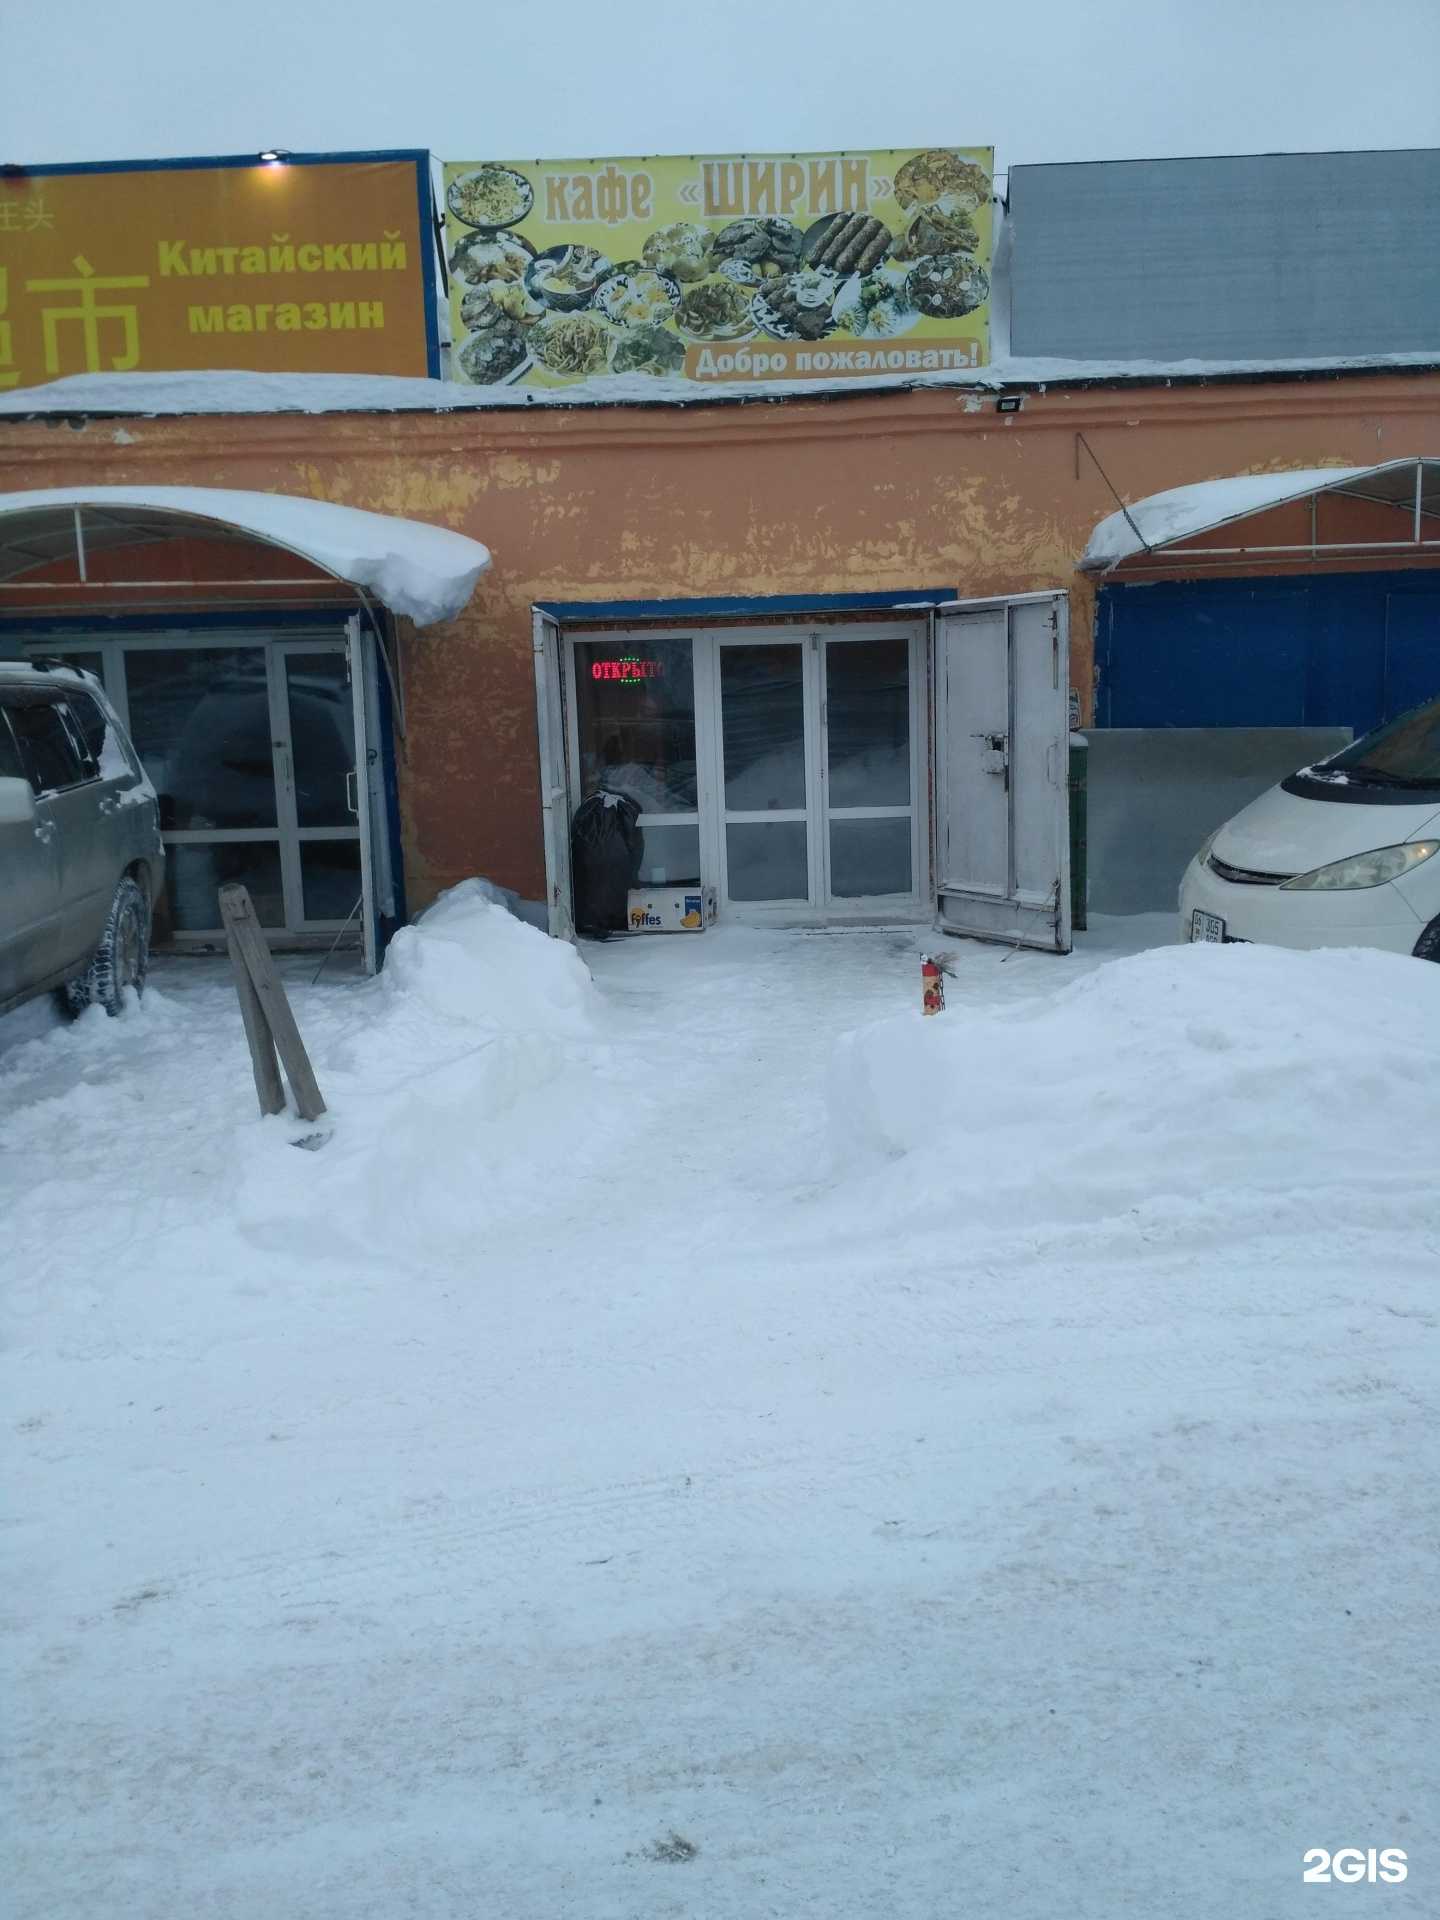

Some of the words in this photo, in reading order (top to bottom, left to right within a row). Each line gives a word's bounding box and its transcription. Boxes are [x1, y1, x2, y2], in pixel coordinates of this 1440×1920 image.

[544, 164, 652, 225] кафе
[157, 229, 408, 278] Китайский
[0, 255, 151, 387] 市
[187, 301, 386, 334] магазин
[695, 347, 788, 378] Добро
[795, 342, 979, 371] пожаловать!
